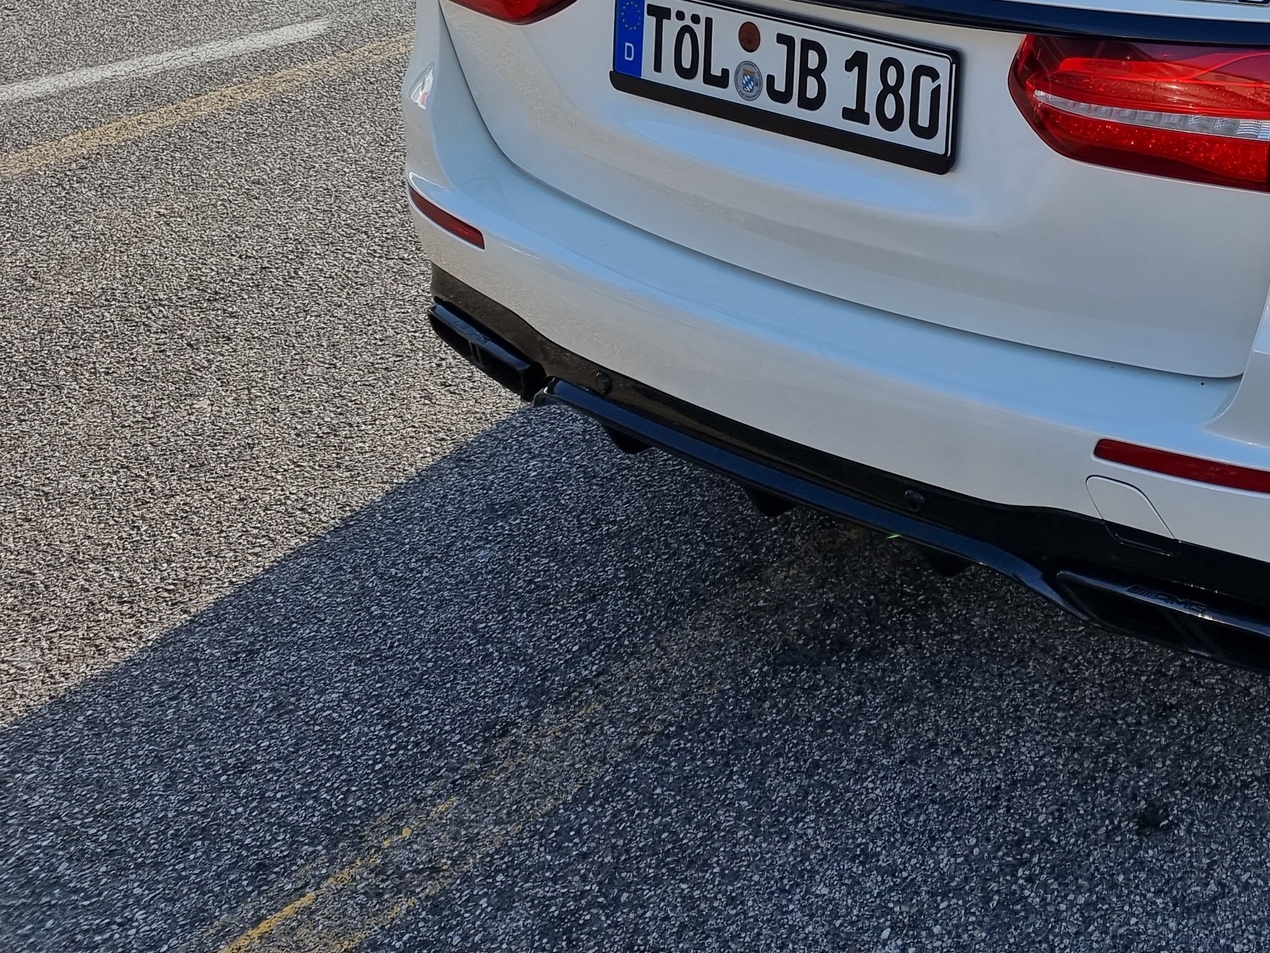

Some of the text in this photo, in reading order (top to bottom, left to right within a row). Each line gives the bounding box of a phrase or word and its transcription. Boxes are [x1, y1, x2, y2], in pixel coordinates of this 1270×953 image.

[624, 42, 634, 61] D
[647, 3, 730, 89] TÖL
[766, 32, 828, 111] JB
[841, 50, 941, 140] 180
